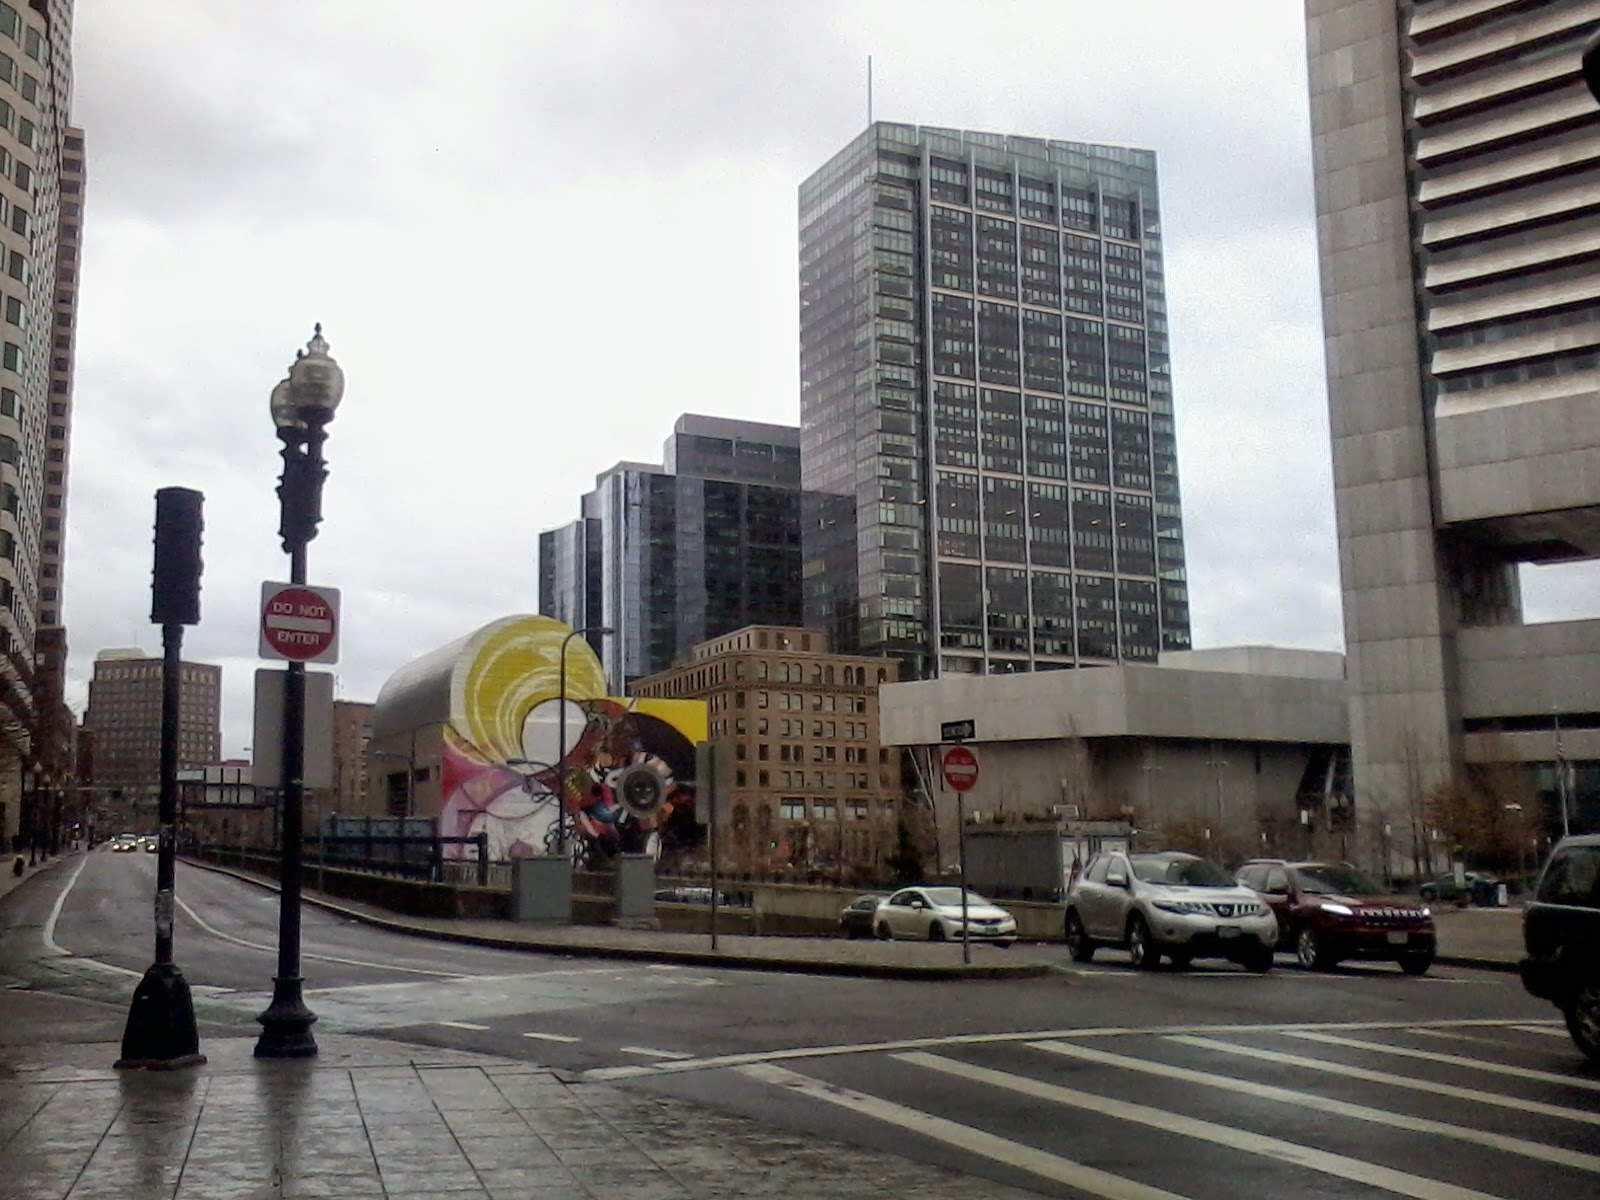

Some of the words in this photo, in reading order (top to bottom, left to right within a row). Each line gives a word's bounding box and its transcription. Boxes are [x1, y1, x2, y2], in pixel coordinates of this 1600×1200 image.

[272, 602, 293, 614] DO
[300, 604, 326, 617] NOT
[277, 631, 320, 645] ENTER
